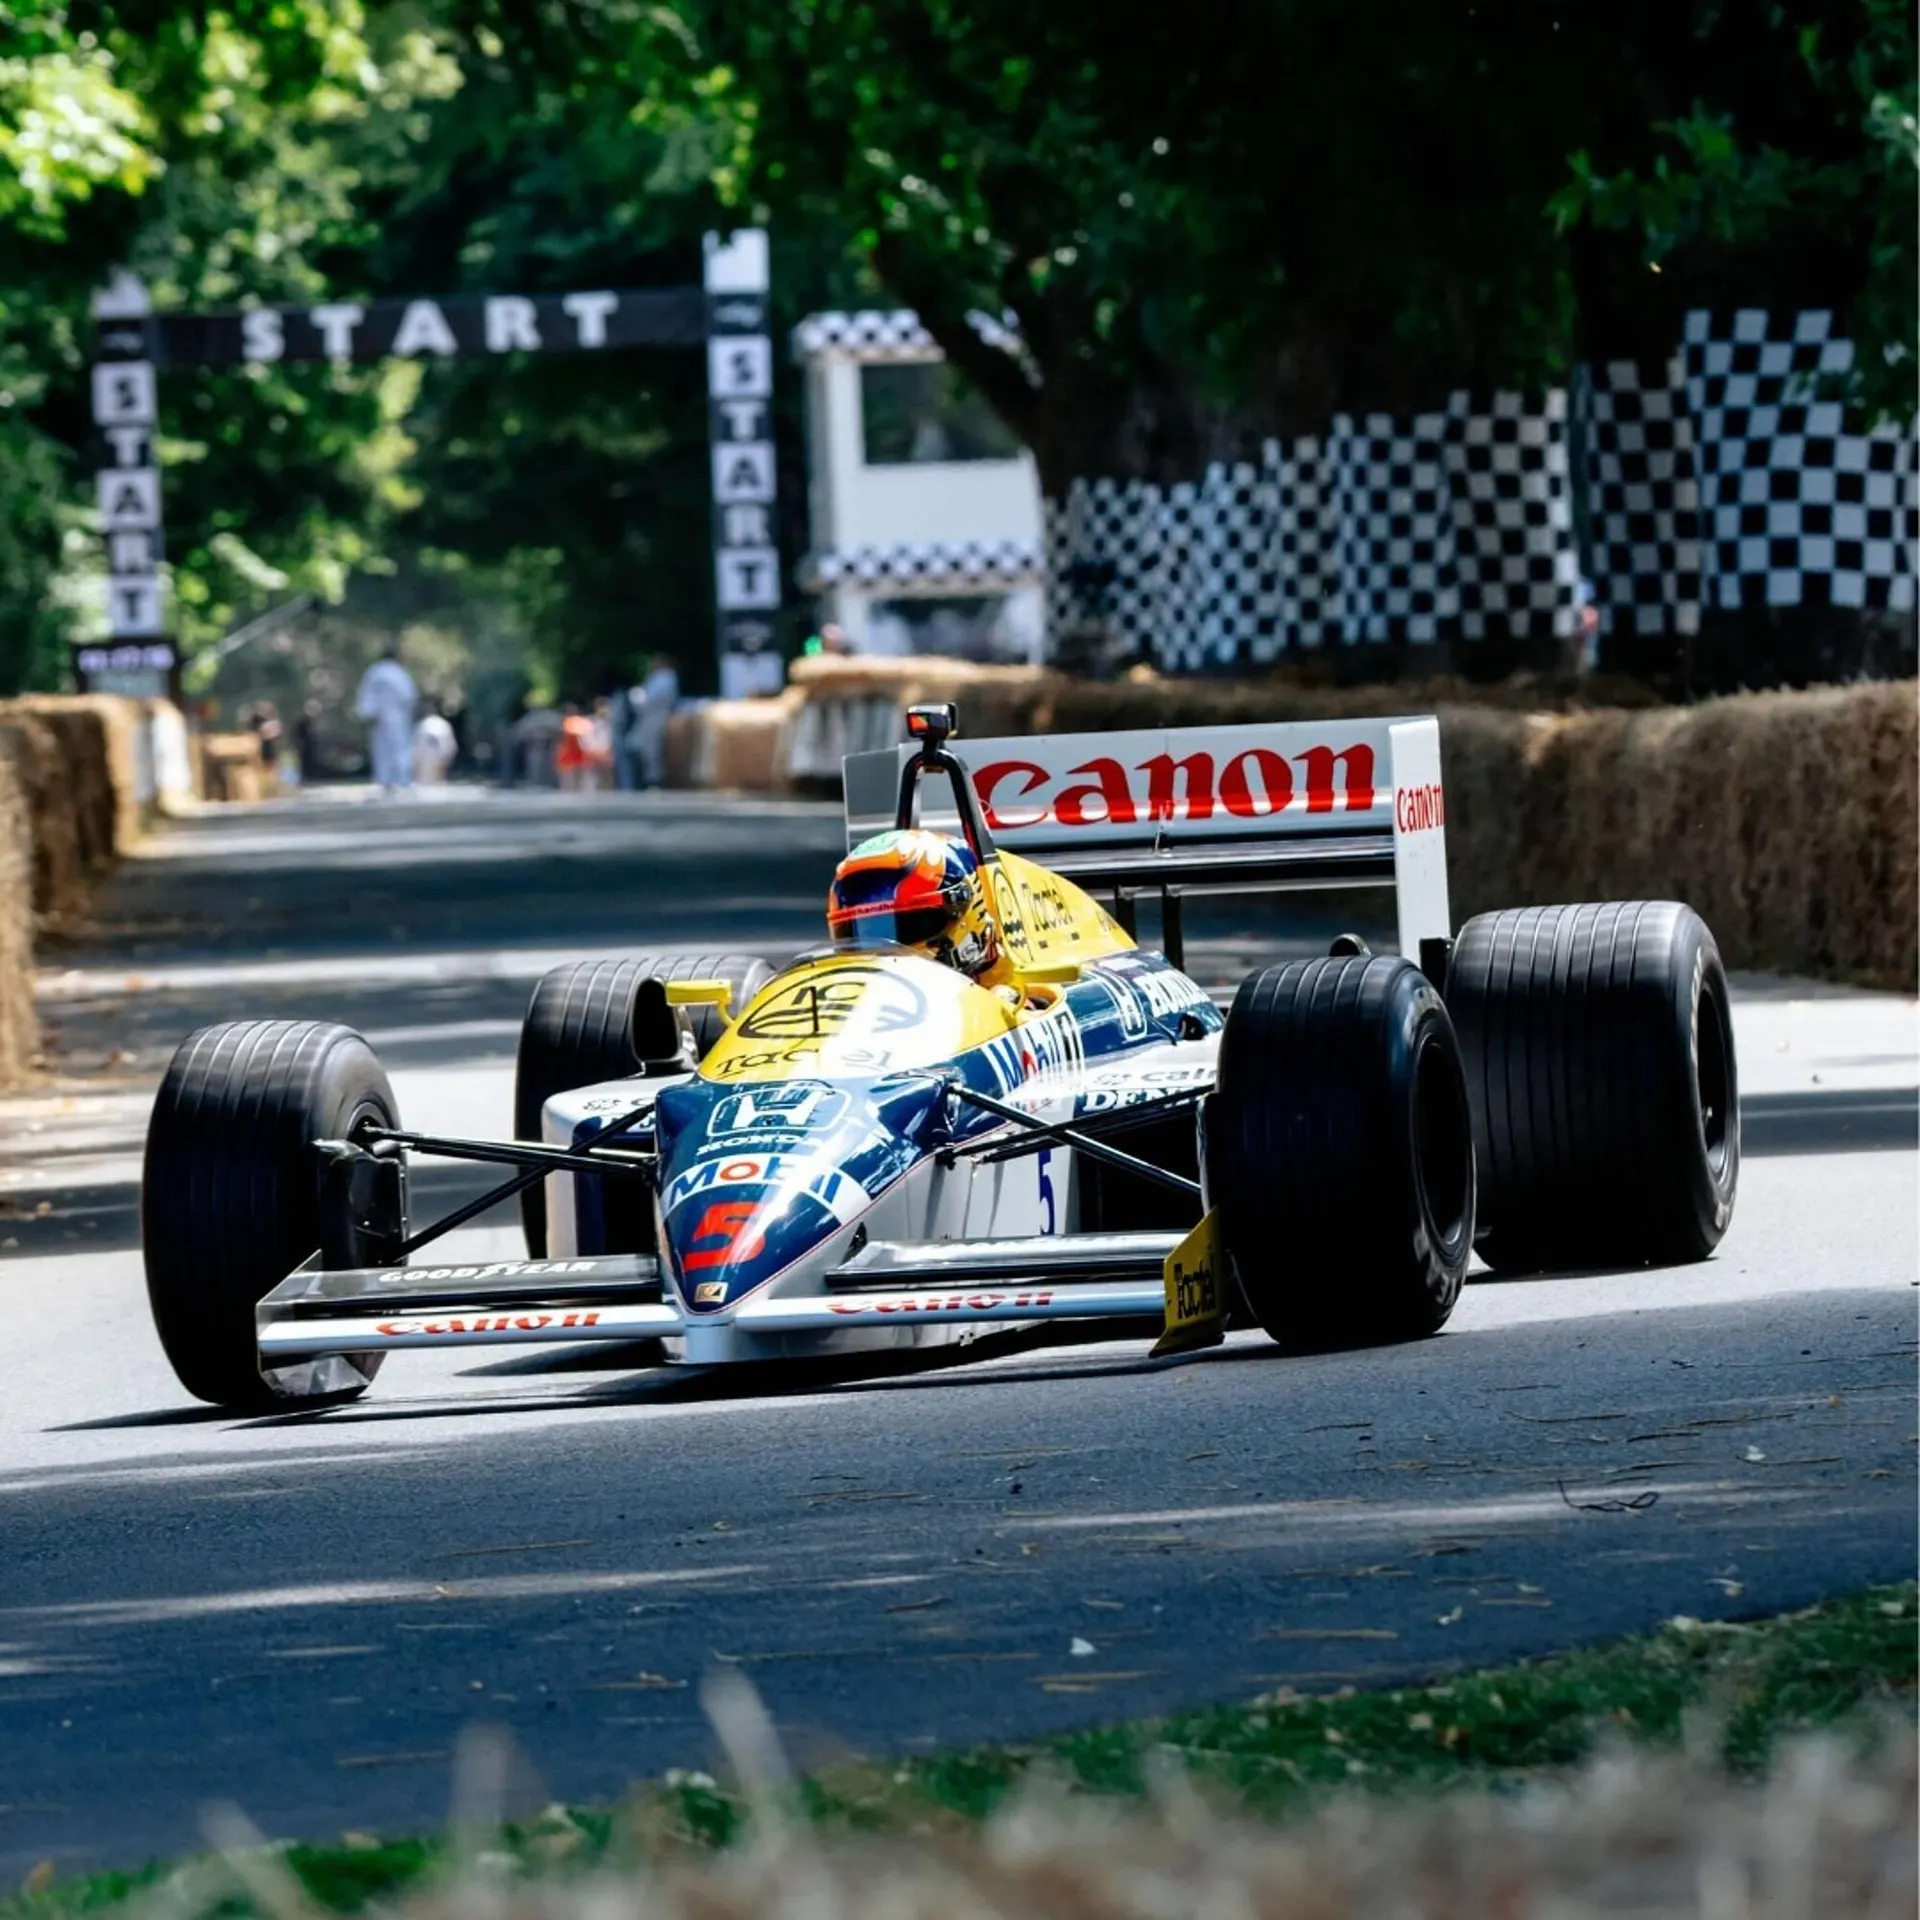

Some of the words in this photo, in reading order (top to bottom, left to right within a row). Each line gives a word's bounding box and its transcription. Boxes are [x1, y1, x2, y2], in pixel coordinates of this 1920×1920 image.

[242, 291, 618, 361] START
[720, 352, 768, 595] START
[972, 743, 1375, 830] Canon
[1397, 784, 1444, 833] Canon
[715, 1048, 892, 1077] Tacel
[683, 1201, 766, 1273] 5
[379, 1261, 597, 1283] GOODYEAR
[376, 1312, 600, 1336] Canon
